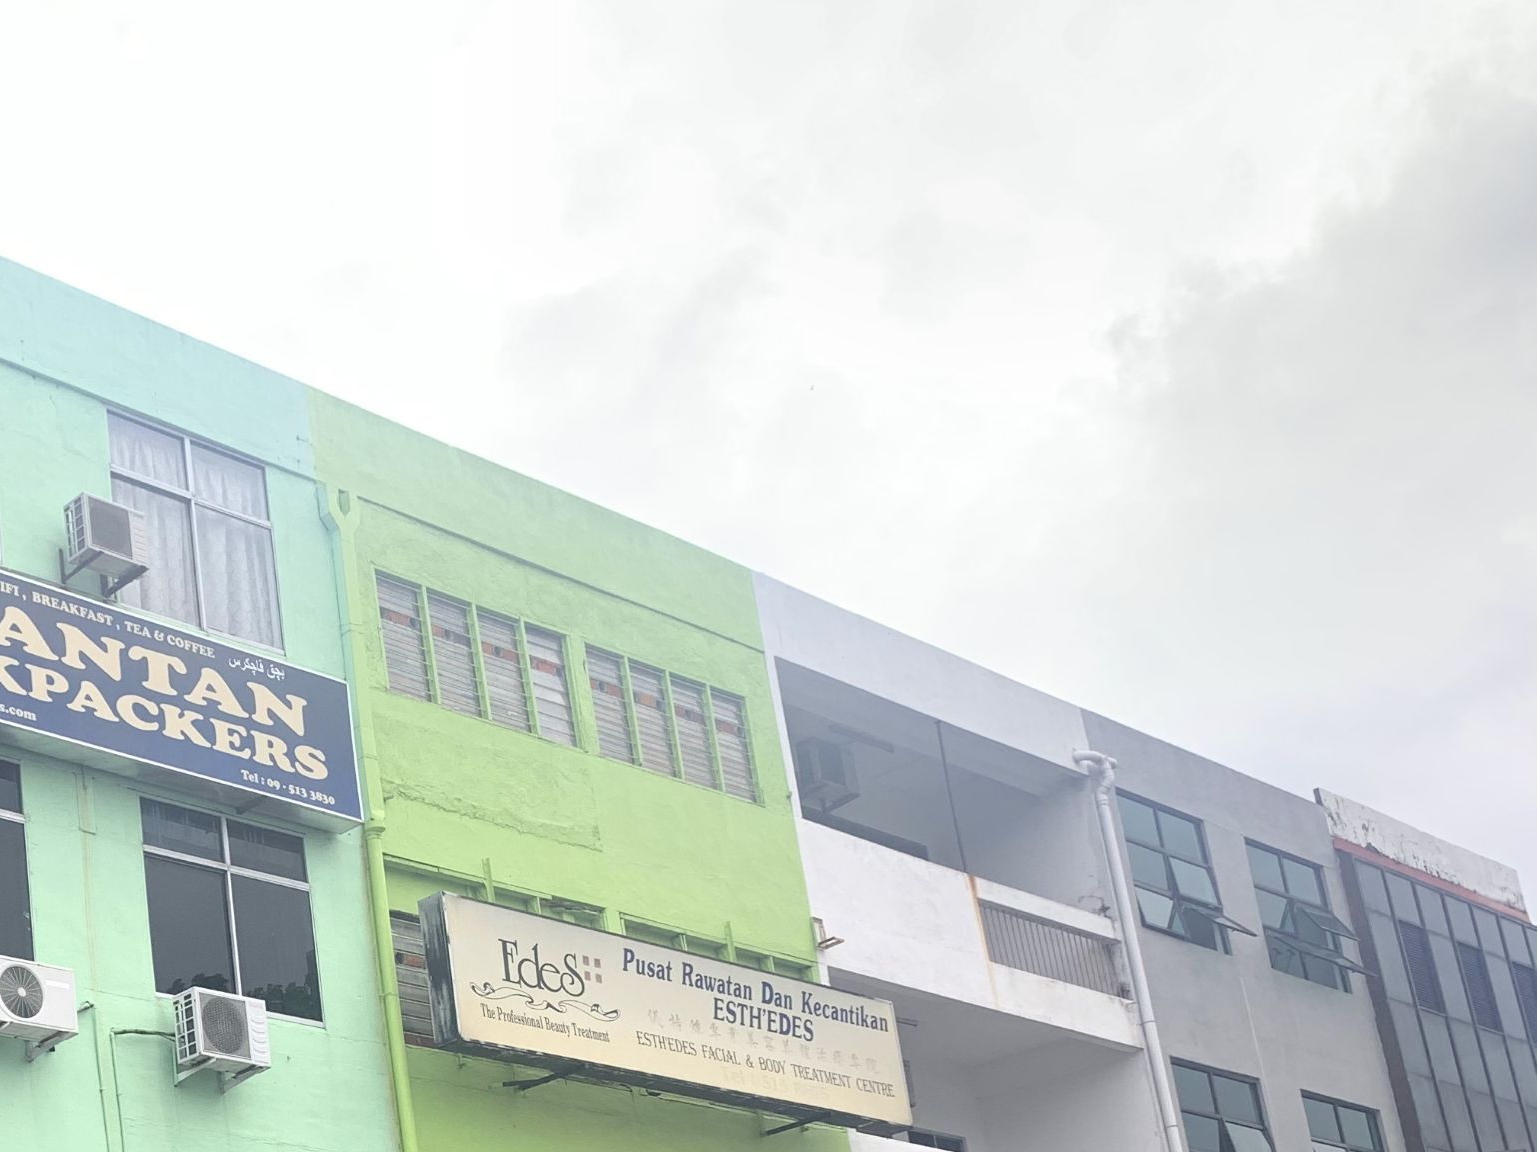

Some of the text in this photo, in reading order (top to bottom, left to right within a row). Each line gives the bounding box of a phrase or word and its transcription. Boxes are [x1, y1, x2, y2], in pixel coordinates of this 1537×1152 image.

[124, 620, 152, 637] TEA
[153, 628, 165, 641] &
[166, 634, 216, 659] COFFEE
[289, 785, 307, 797] 513
[310, 790, 335, 804] 3830
[623, 949, 889, 1033] Pusat Rawatan Dan Kecantikan
[481, 1003, 610, 1043] The Professional Beauty Treatment
[702, 1045, 741, 1067] FACIAL
[746, 1055, 755, 1069] &
[759, 1056, 787, 1076] BODY
[790, 1063, 854, 1089] TREATMENT
[856, 1077, 896, 1098] CENTRE
